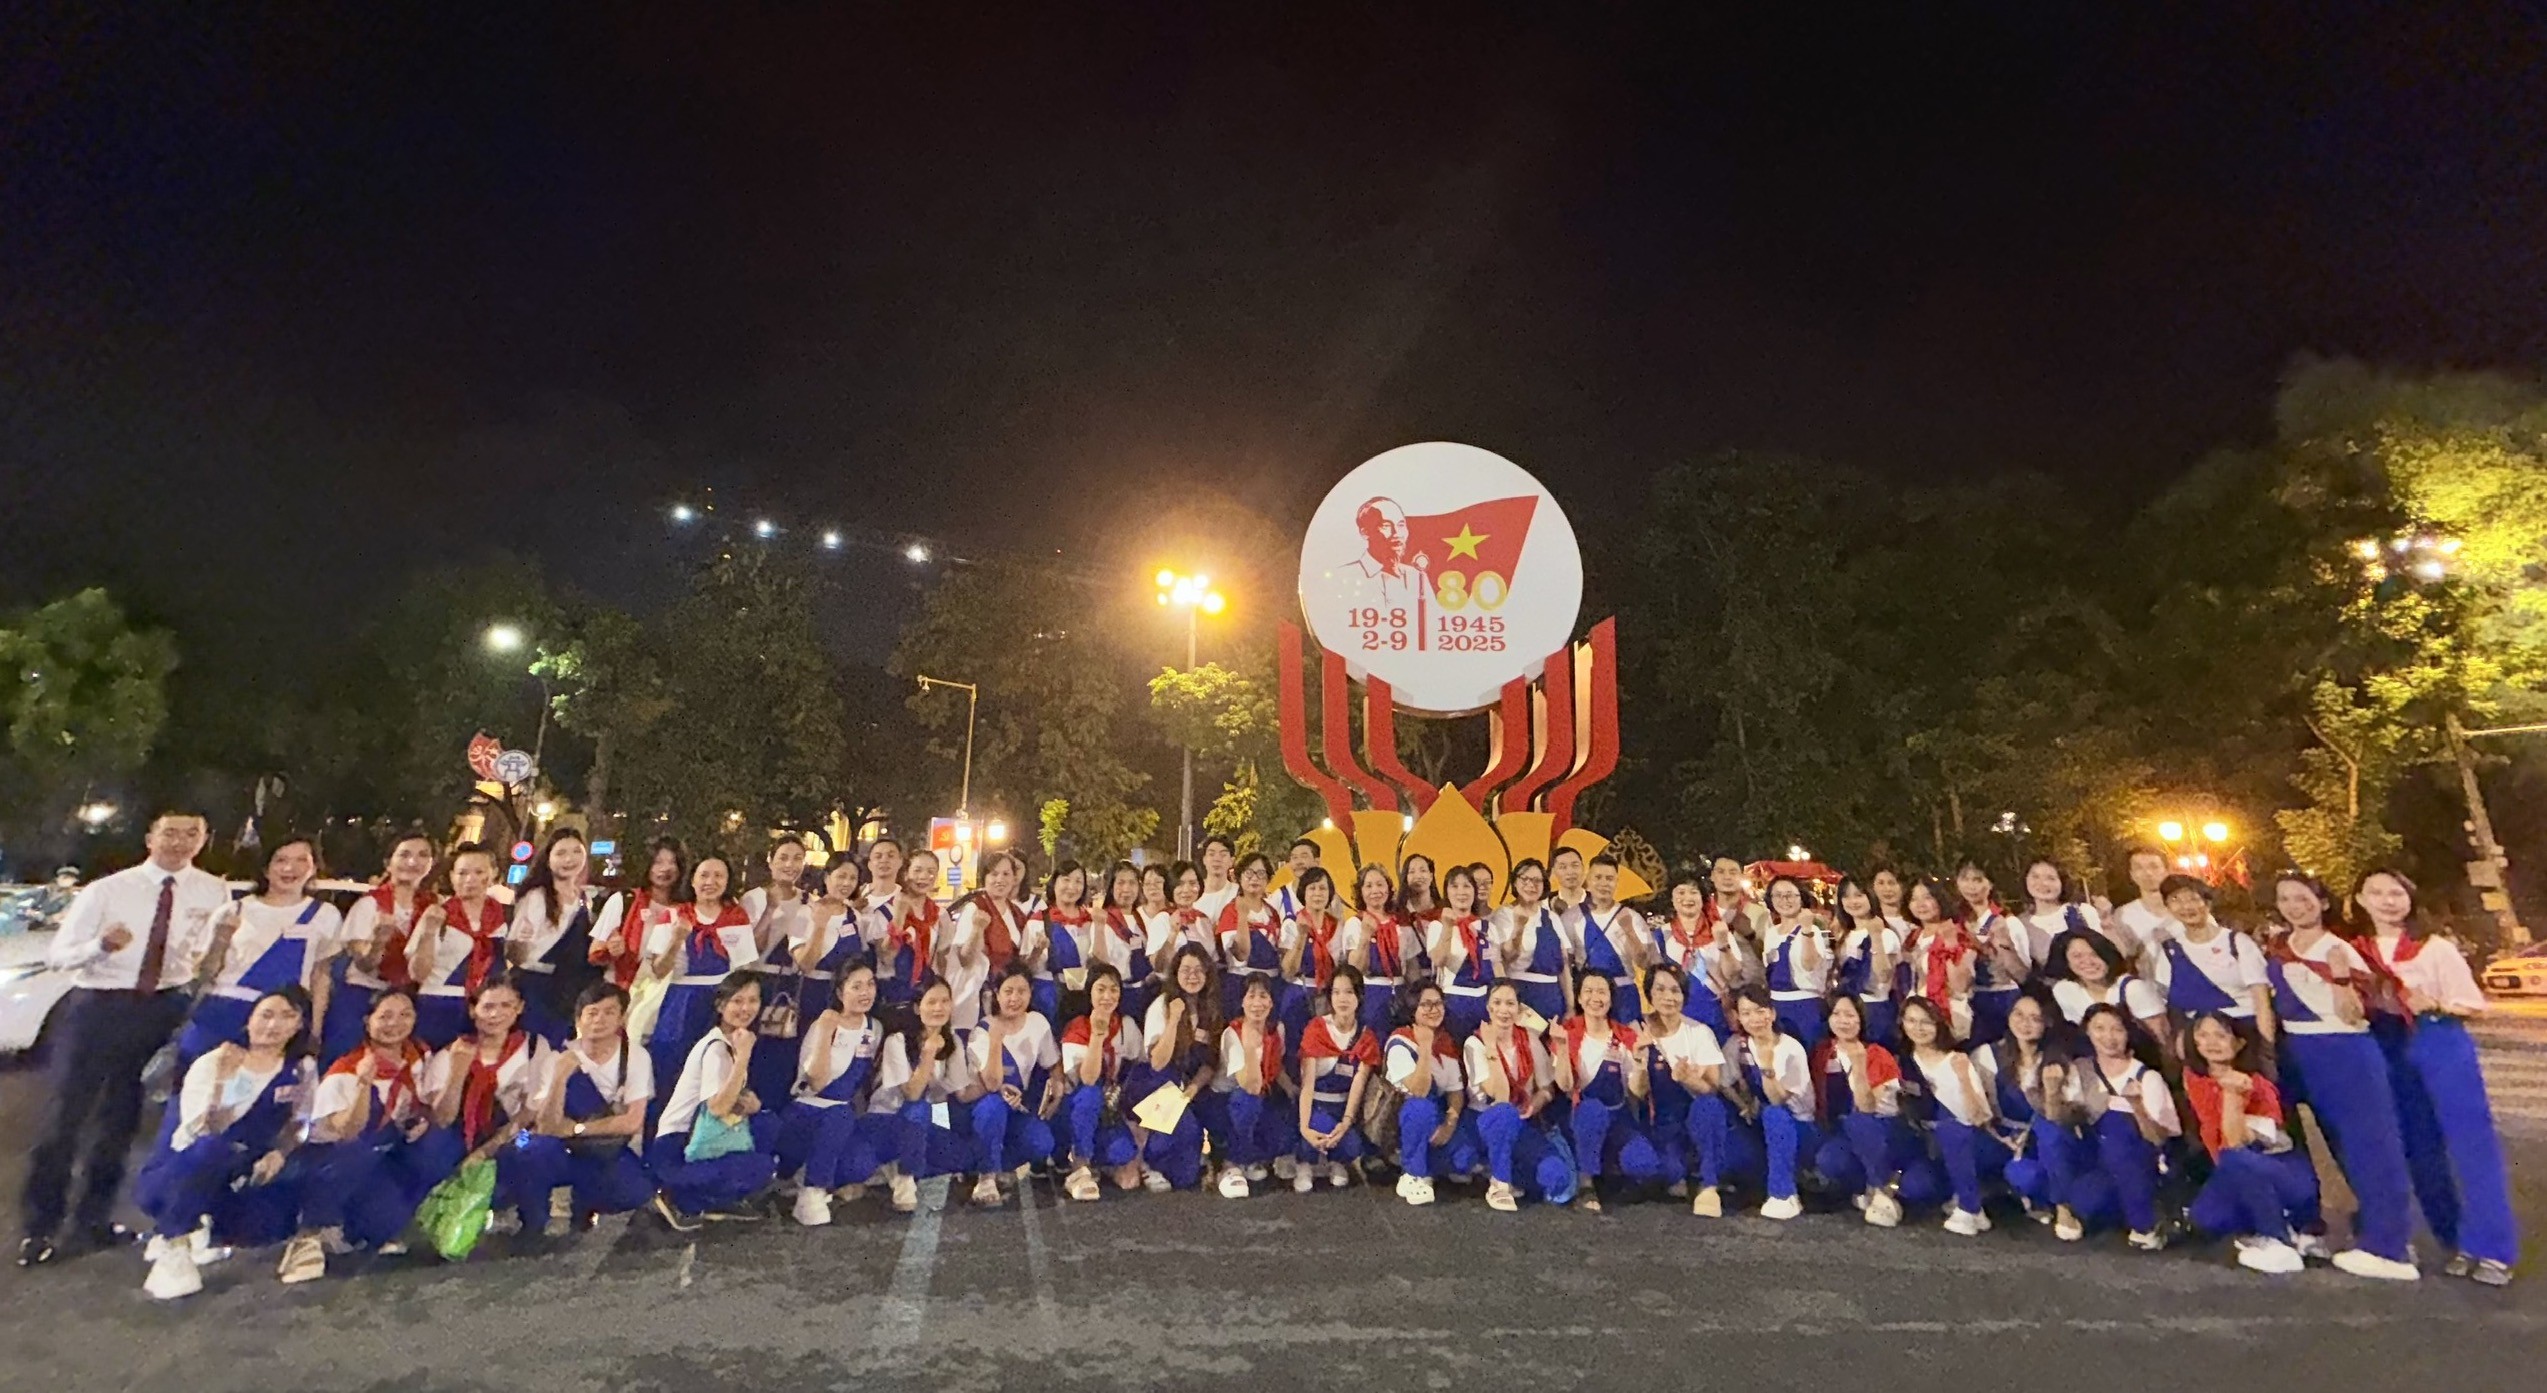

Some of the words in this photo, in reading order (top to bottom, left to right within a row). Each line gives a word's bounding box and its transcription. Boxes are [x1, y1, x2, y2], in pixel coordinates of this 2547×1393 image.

[1436, 570, 1508, 611] 80
[1348, 608, 1407, 628] 19-8
[1437, 616, 1505, 633] 1945
[1362, 631, 1408, 651] 2-9
[1438, 635, 1506, 651] 2025
